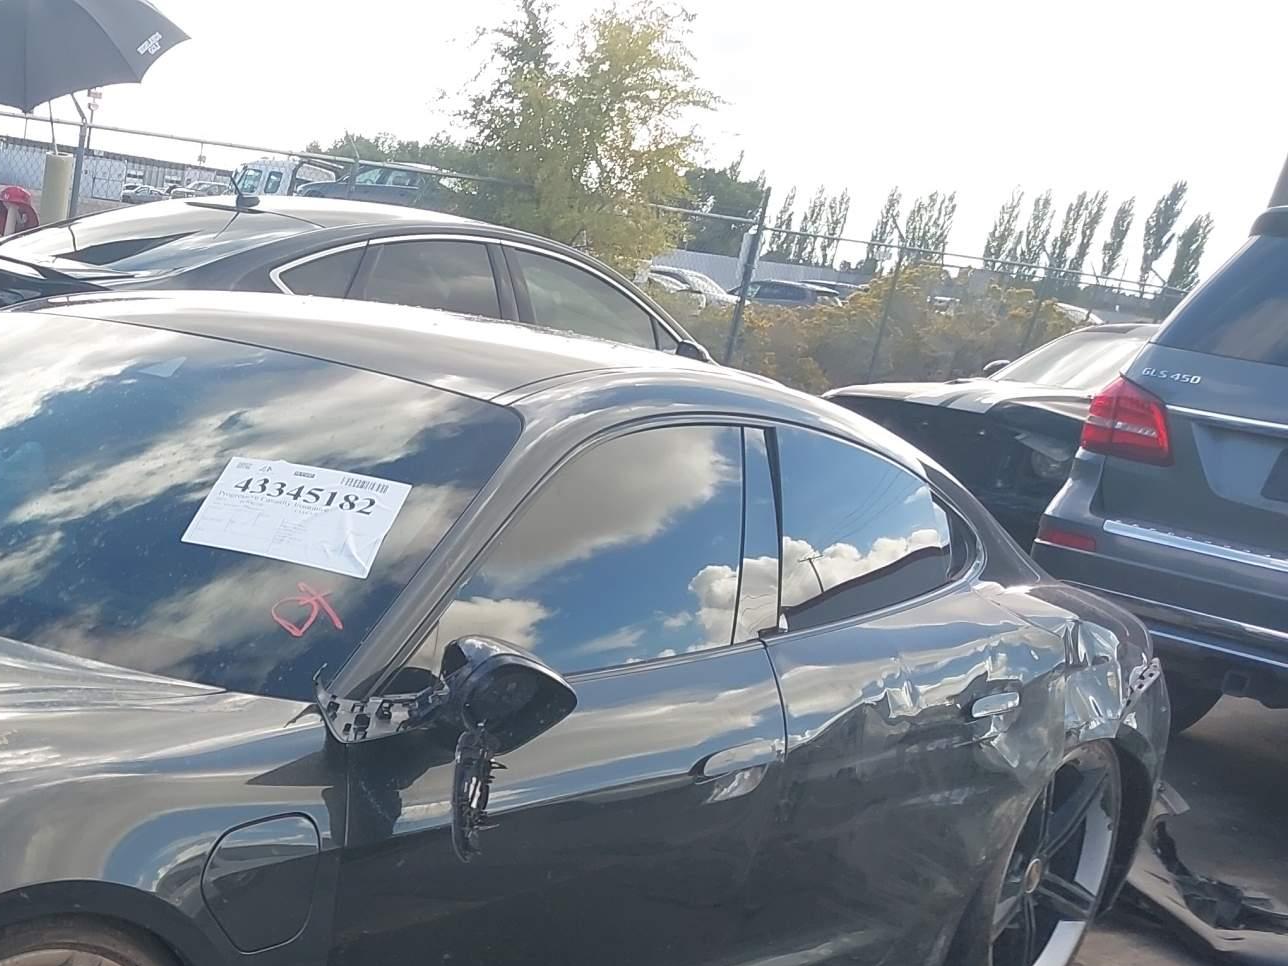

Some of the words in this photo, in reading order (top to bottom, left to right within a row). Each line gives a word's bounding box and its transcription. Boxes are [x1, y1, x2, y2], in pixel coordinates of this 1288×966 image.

[1141, 367, 1168, 379] GLS
[1169, 372, 1203, 385] 450
[234, 477, 376, 516] 43345182
